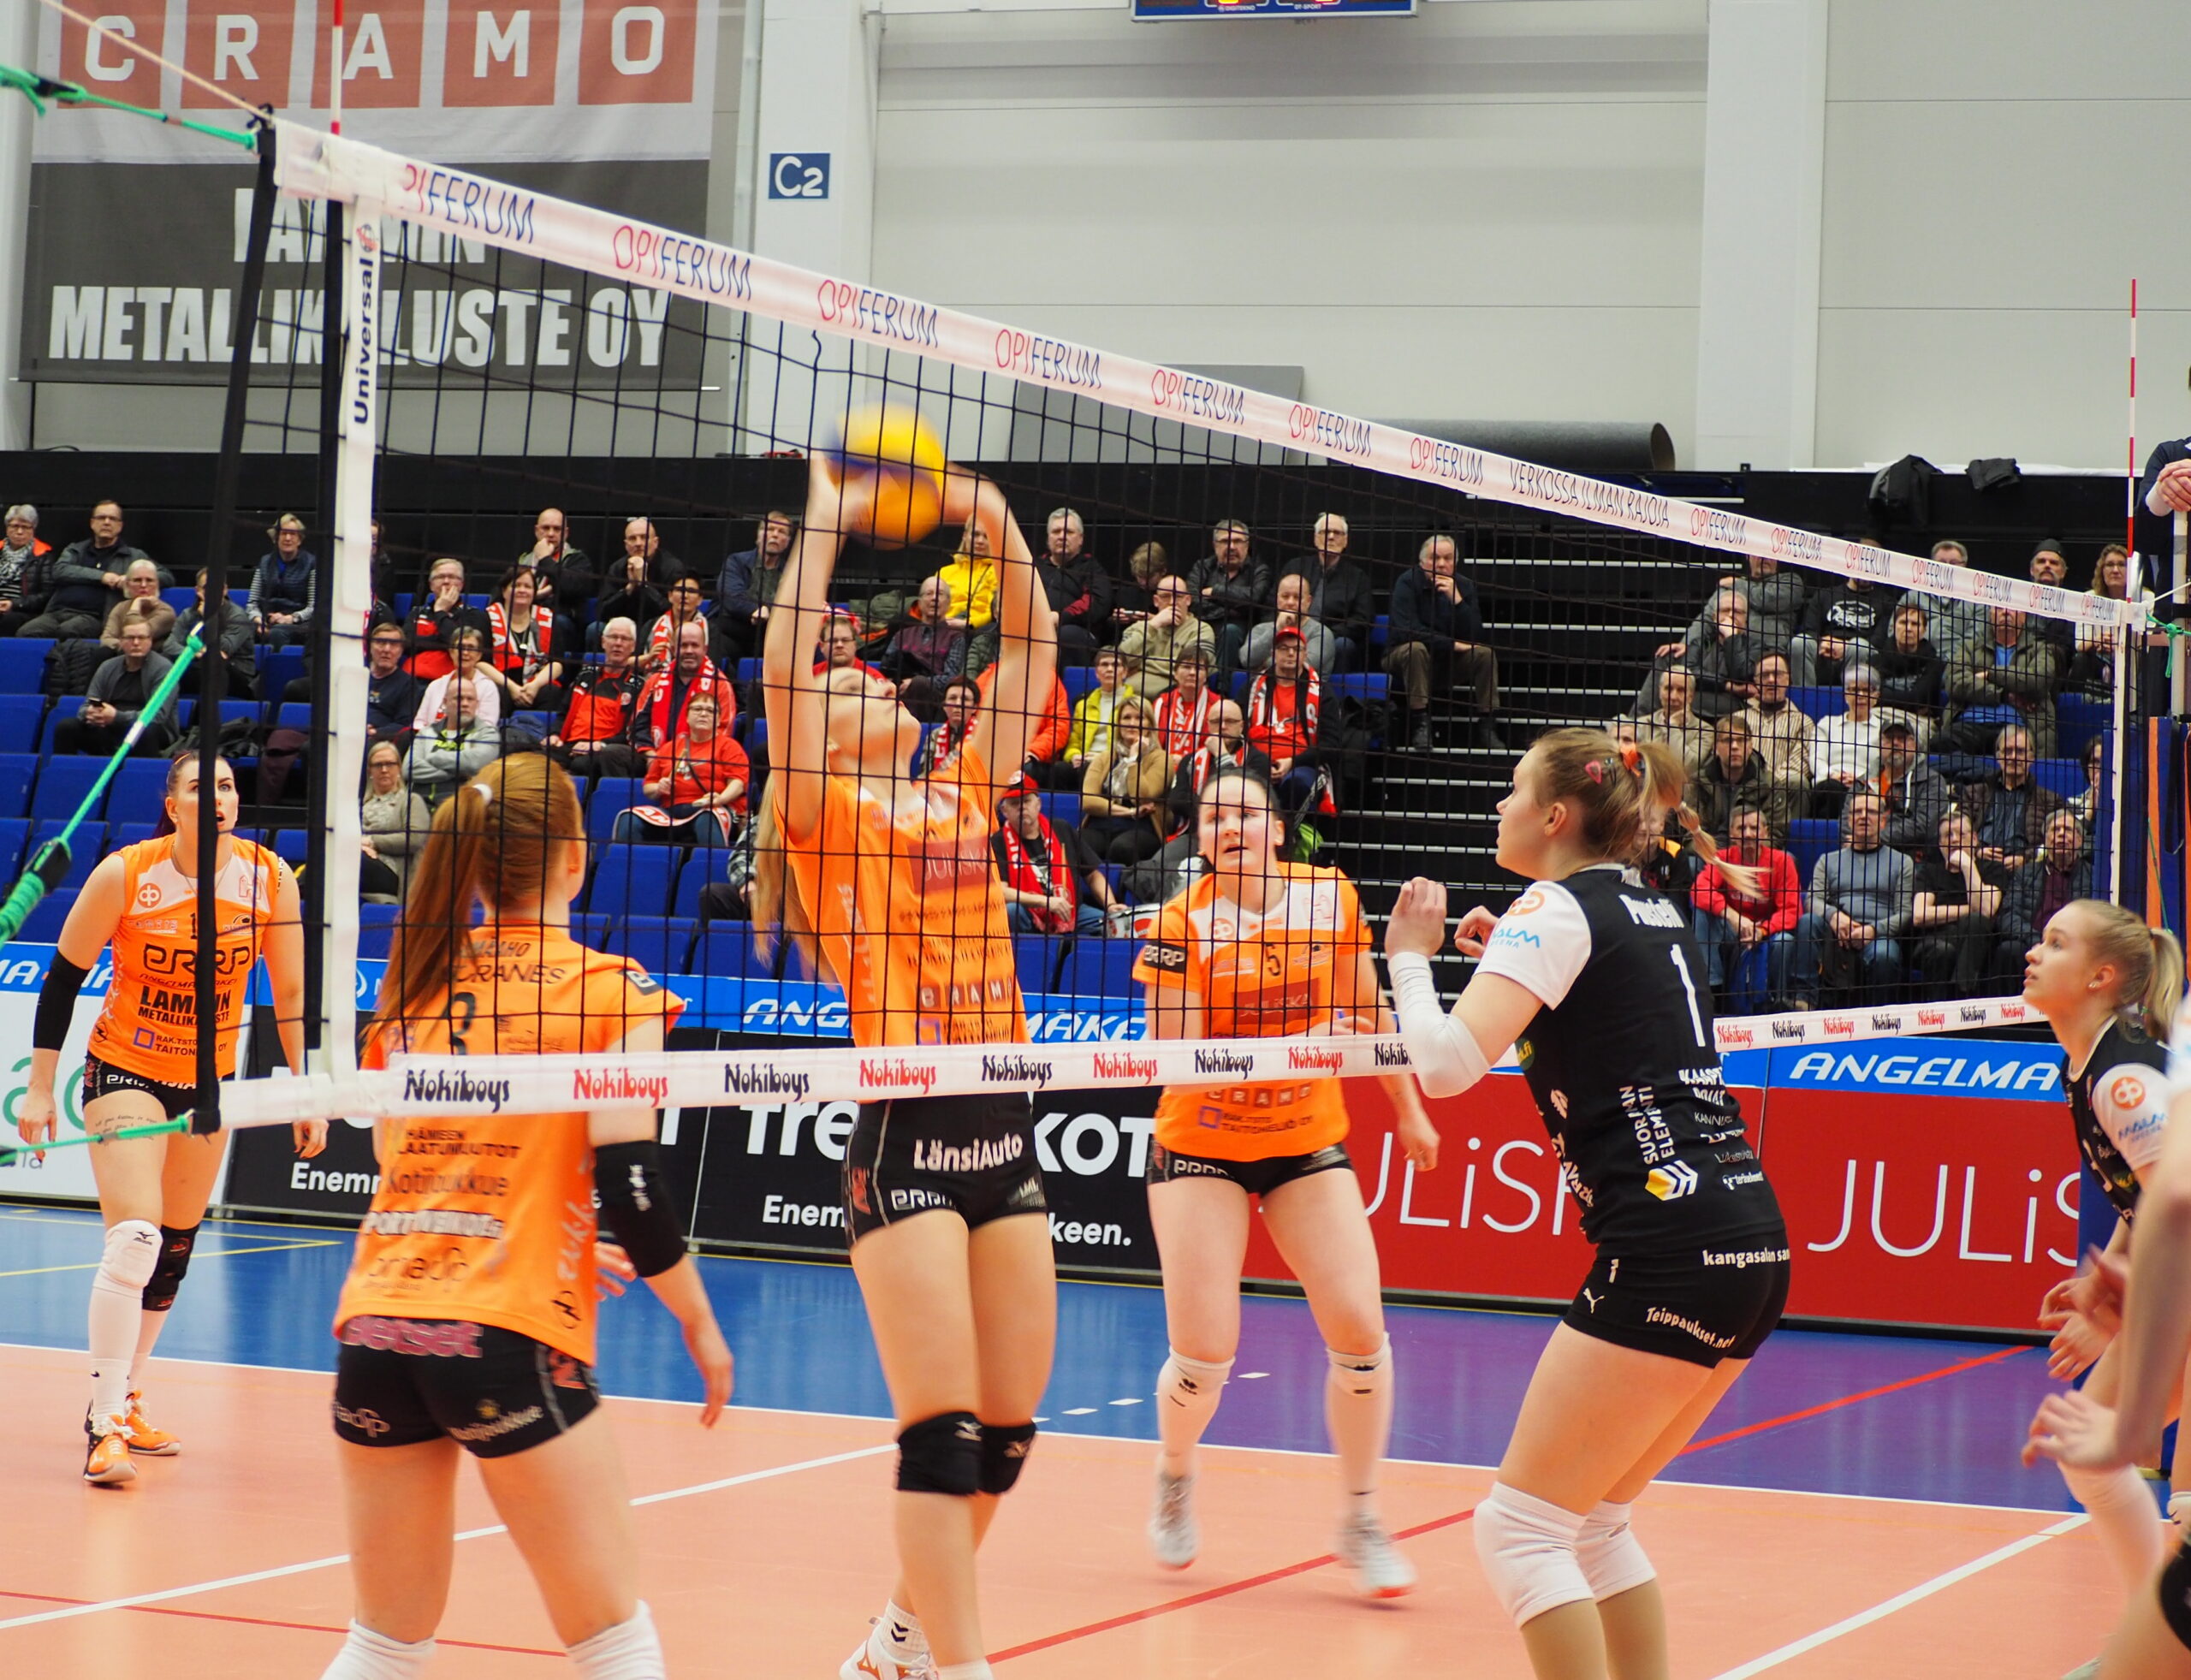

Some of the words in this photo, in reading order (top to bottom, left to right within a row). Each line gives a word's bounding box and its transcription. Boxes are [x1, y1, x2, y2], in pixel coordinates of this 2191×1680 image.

[85, 7, 665, 81] CRAMO
[774, 156, 824, 198] C2
[613, 224, 751, 302] OPIFERUM
[585, 287, 671, 368] OY
[817, 280, 939, 349] OPIFERUM
[353, 258, 374, 424] Universal
[995, 329, 1102, 390] OPIFERUM
[1151, 370, 1244, 425] OPIFERUM
[1289, 404, 1372, 458] OPIFERUM
[1410, 437, 1484, 486] OPIFERUM
[1510, 460, 1578, 507] VERKOSSA
[1582, 478, 1624, 518] ILMAN
[1627, 490, 1670, 529] RAJOJA
[1691, 508, 1747, 546] OPIFERUM
[1771, 527, 1823, 561] OPIFERUM
[1845, 543, 1891, 579] OPIFERUM
[1912, 558, 1955, 592] OPIFERUM
[1973, 572, 2012, 603] OPIFERUM
[1671, 943, 1706, 1047] 1
[859, 1059, 937, 1095] Nokiboys
[982, 1054, 1053, 1092] Nokiboys
[1093, 1052, 1158, 1086] Nokiboys
[1195, 1048, 1254, 1080] Nokiboys
[1288, 1046, 1344, 1076] Nokiboys
[1790, 1052, 2061, 1092] ANGELMA
[404, 1069, 511, 1113] Nokiboys
[573, 1068, 669, 1108] Nokiboys
[724, 1063, 810, 1101] Nokiboys
[913, 1132, 1024, 1172] LänsiAuto
[1701, 1247, 1776, 1268] kangasalan
[1646, 1306, 1737, 1349] Teippaukset.net
